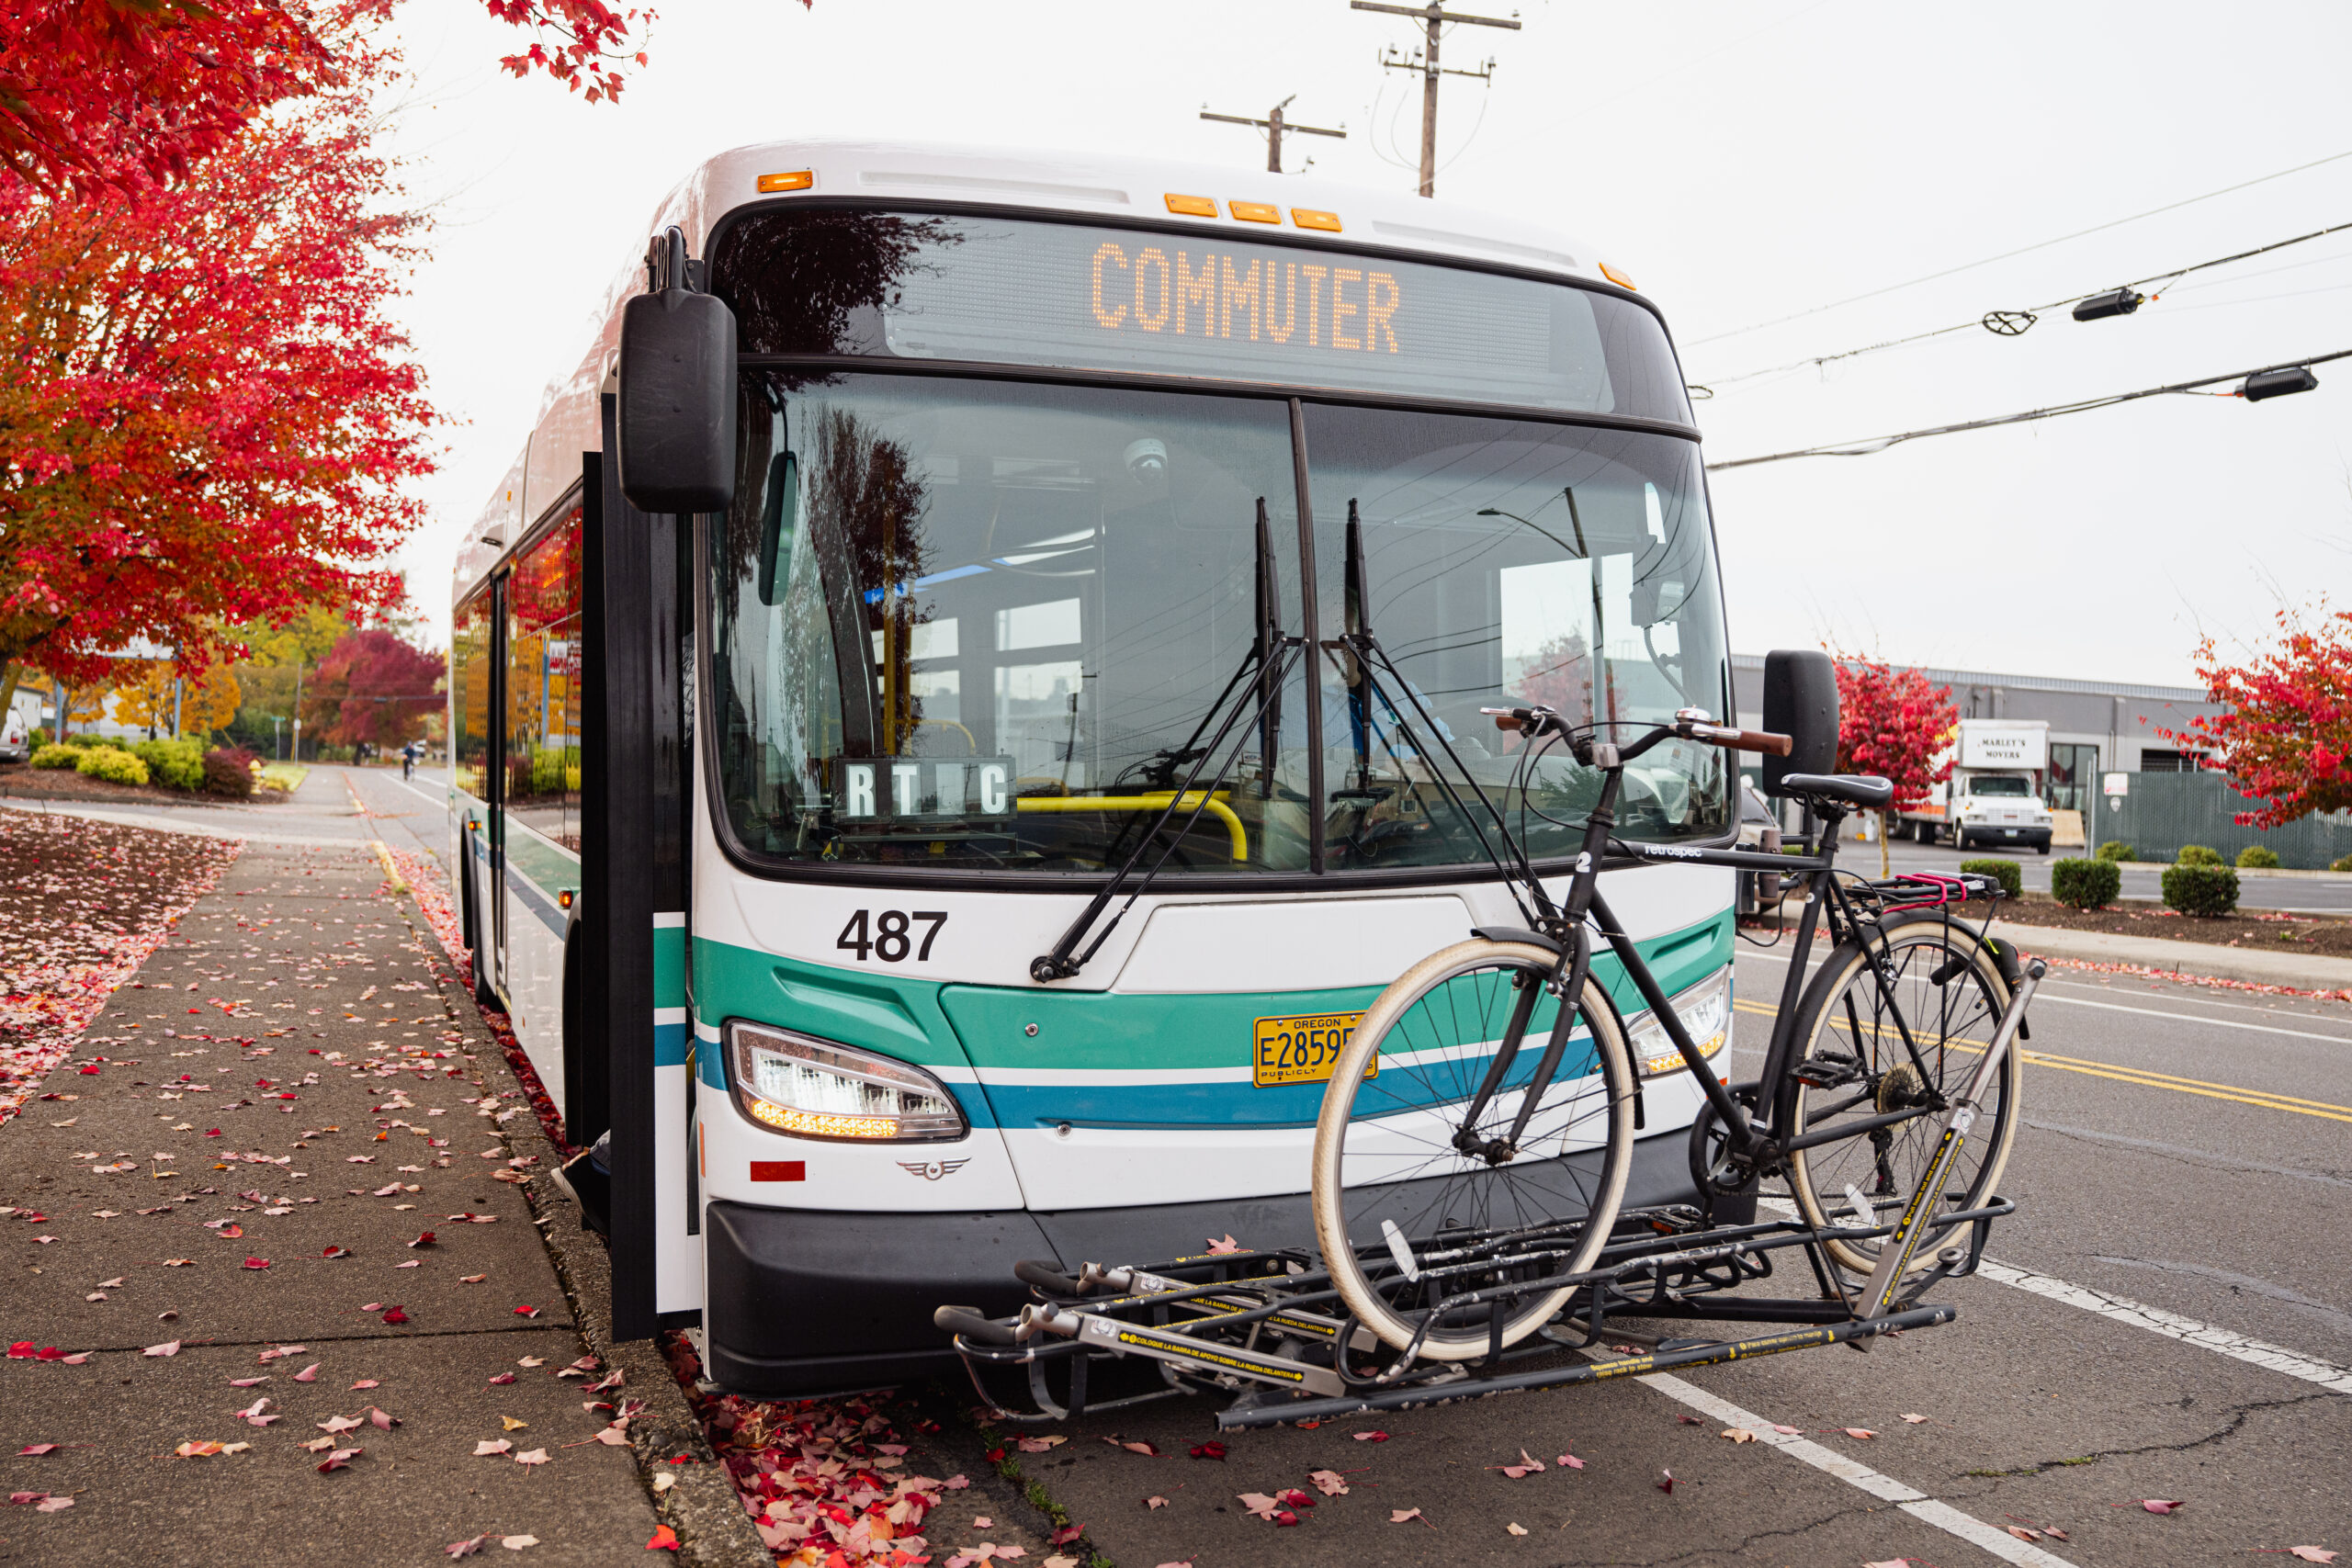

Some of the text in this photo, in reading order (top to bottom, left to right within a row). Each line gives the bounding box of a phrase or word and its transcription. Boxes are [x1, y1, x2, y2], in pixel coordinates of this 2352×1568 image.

[1092, 243, 1399, 353] COMMUTER
[1982, 739, 2026, 747] MARLEY'S
[1985, 750, 2020, 759] MOVERS
[1645, 843, 1702, 858] retrospec
[837, 909, 948, 963] 487
[1294, 1018, 1340, 1029] OREGON
[1261, 1067, 1317, 1077] PUBLICLY
[1213, 1301, 1230, 1311] BARRA
[1281, 1317, 1297, 1326] RUEDA
[1297, 1323, 1327, 1333] DELANTERA
[1136, 1337, 1163, 1348] COLOQUE
[1171, 1345, 1191, 1355] BARRA
[1200, 1351, 1218, 1361] APOYO
[1219, 1356, 1237, 1366] SOBRE
[1245, 1364, 1263, 1372] RUEDA
[1263, 1368, 1294, 1378] DELANTERA
